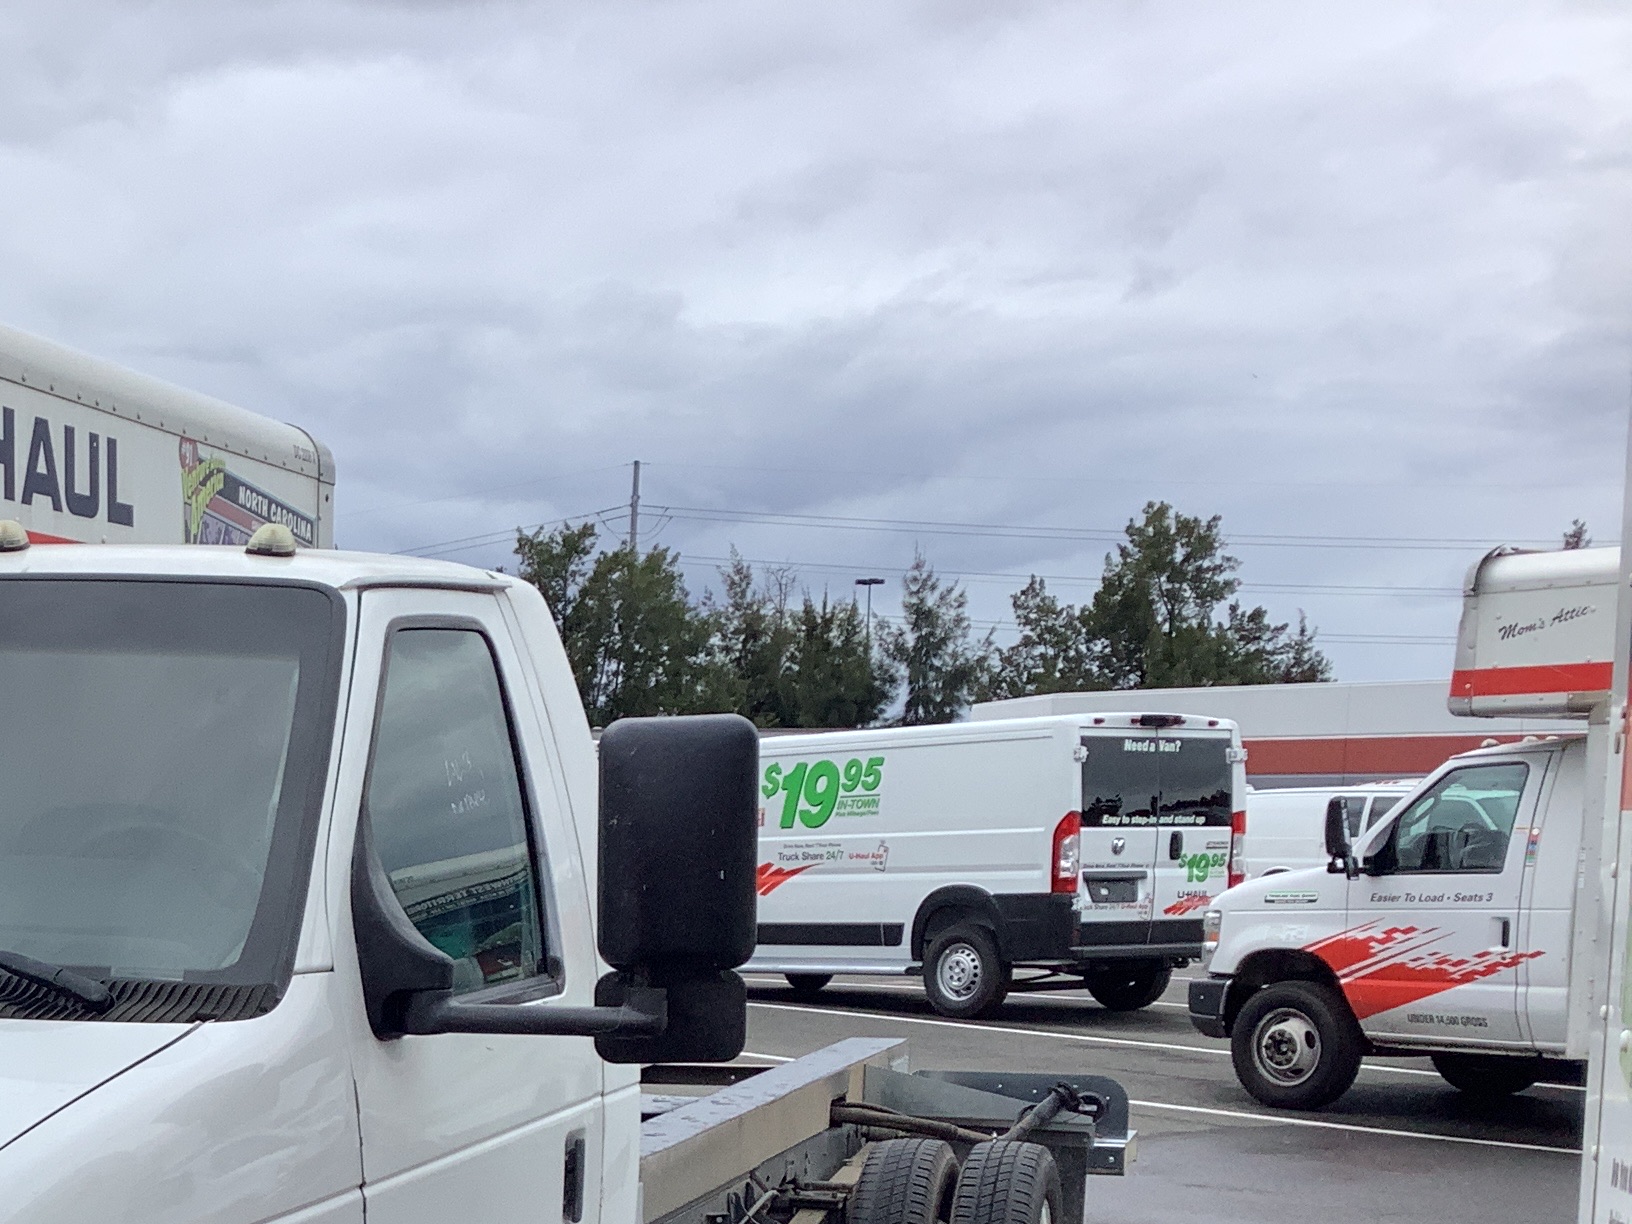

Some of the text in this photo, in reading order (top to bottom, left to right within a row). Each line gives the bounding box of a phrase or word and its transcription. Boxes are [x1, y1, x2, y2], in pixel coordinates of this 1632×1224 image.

[239, 485, 268, 517] NORTH
[270, 503, 312, 542] CAROLINA
[1498, 606, 1590, 640] Mom's Attic
[1124, 739, 1181, 753] Need a Van?
[837, 799, 881, 811] IN-TOWN
[778, 849, 845, 862] Truck Share 24/7
[1370, 892, 1493, 903] Easier To Load Seats 3
[1407, 1013, 1435, 1024] UNDER
